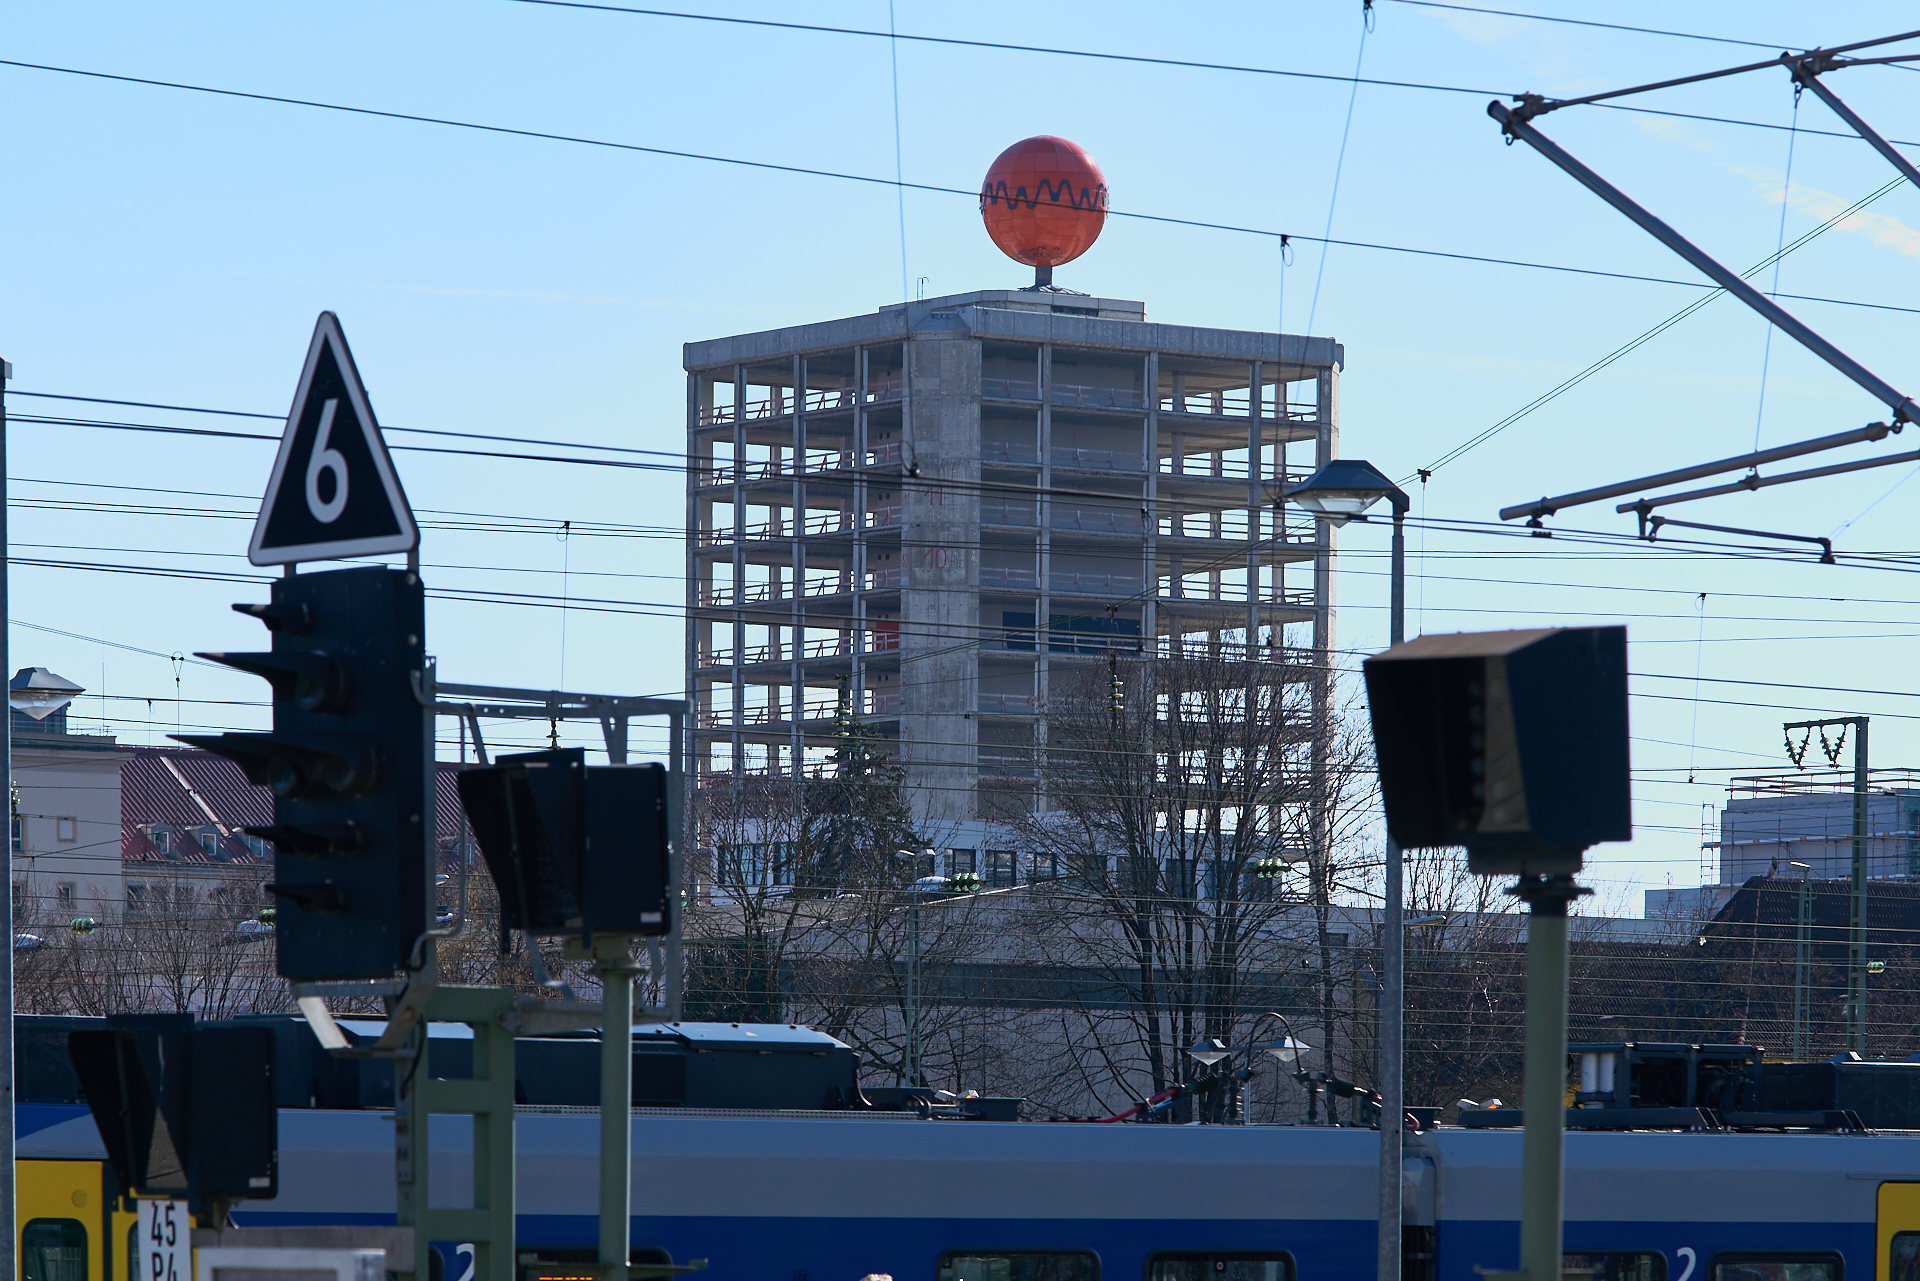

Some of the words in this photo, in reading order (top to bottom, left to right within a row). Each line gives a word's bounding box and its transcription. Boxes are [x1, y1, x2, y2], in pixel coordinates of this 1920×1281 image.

[305, 398, 349, 524] 6
[924, 486, 944, 506] 11
[923, 547, 947, 570] 10
[150, 1201, 177, 1247] 45
[1677, 1246, 1697, 1281] 2
